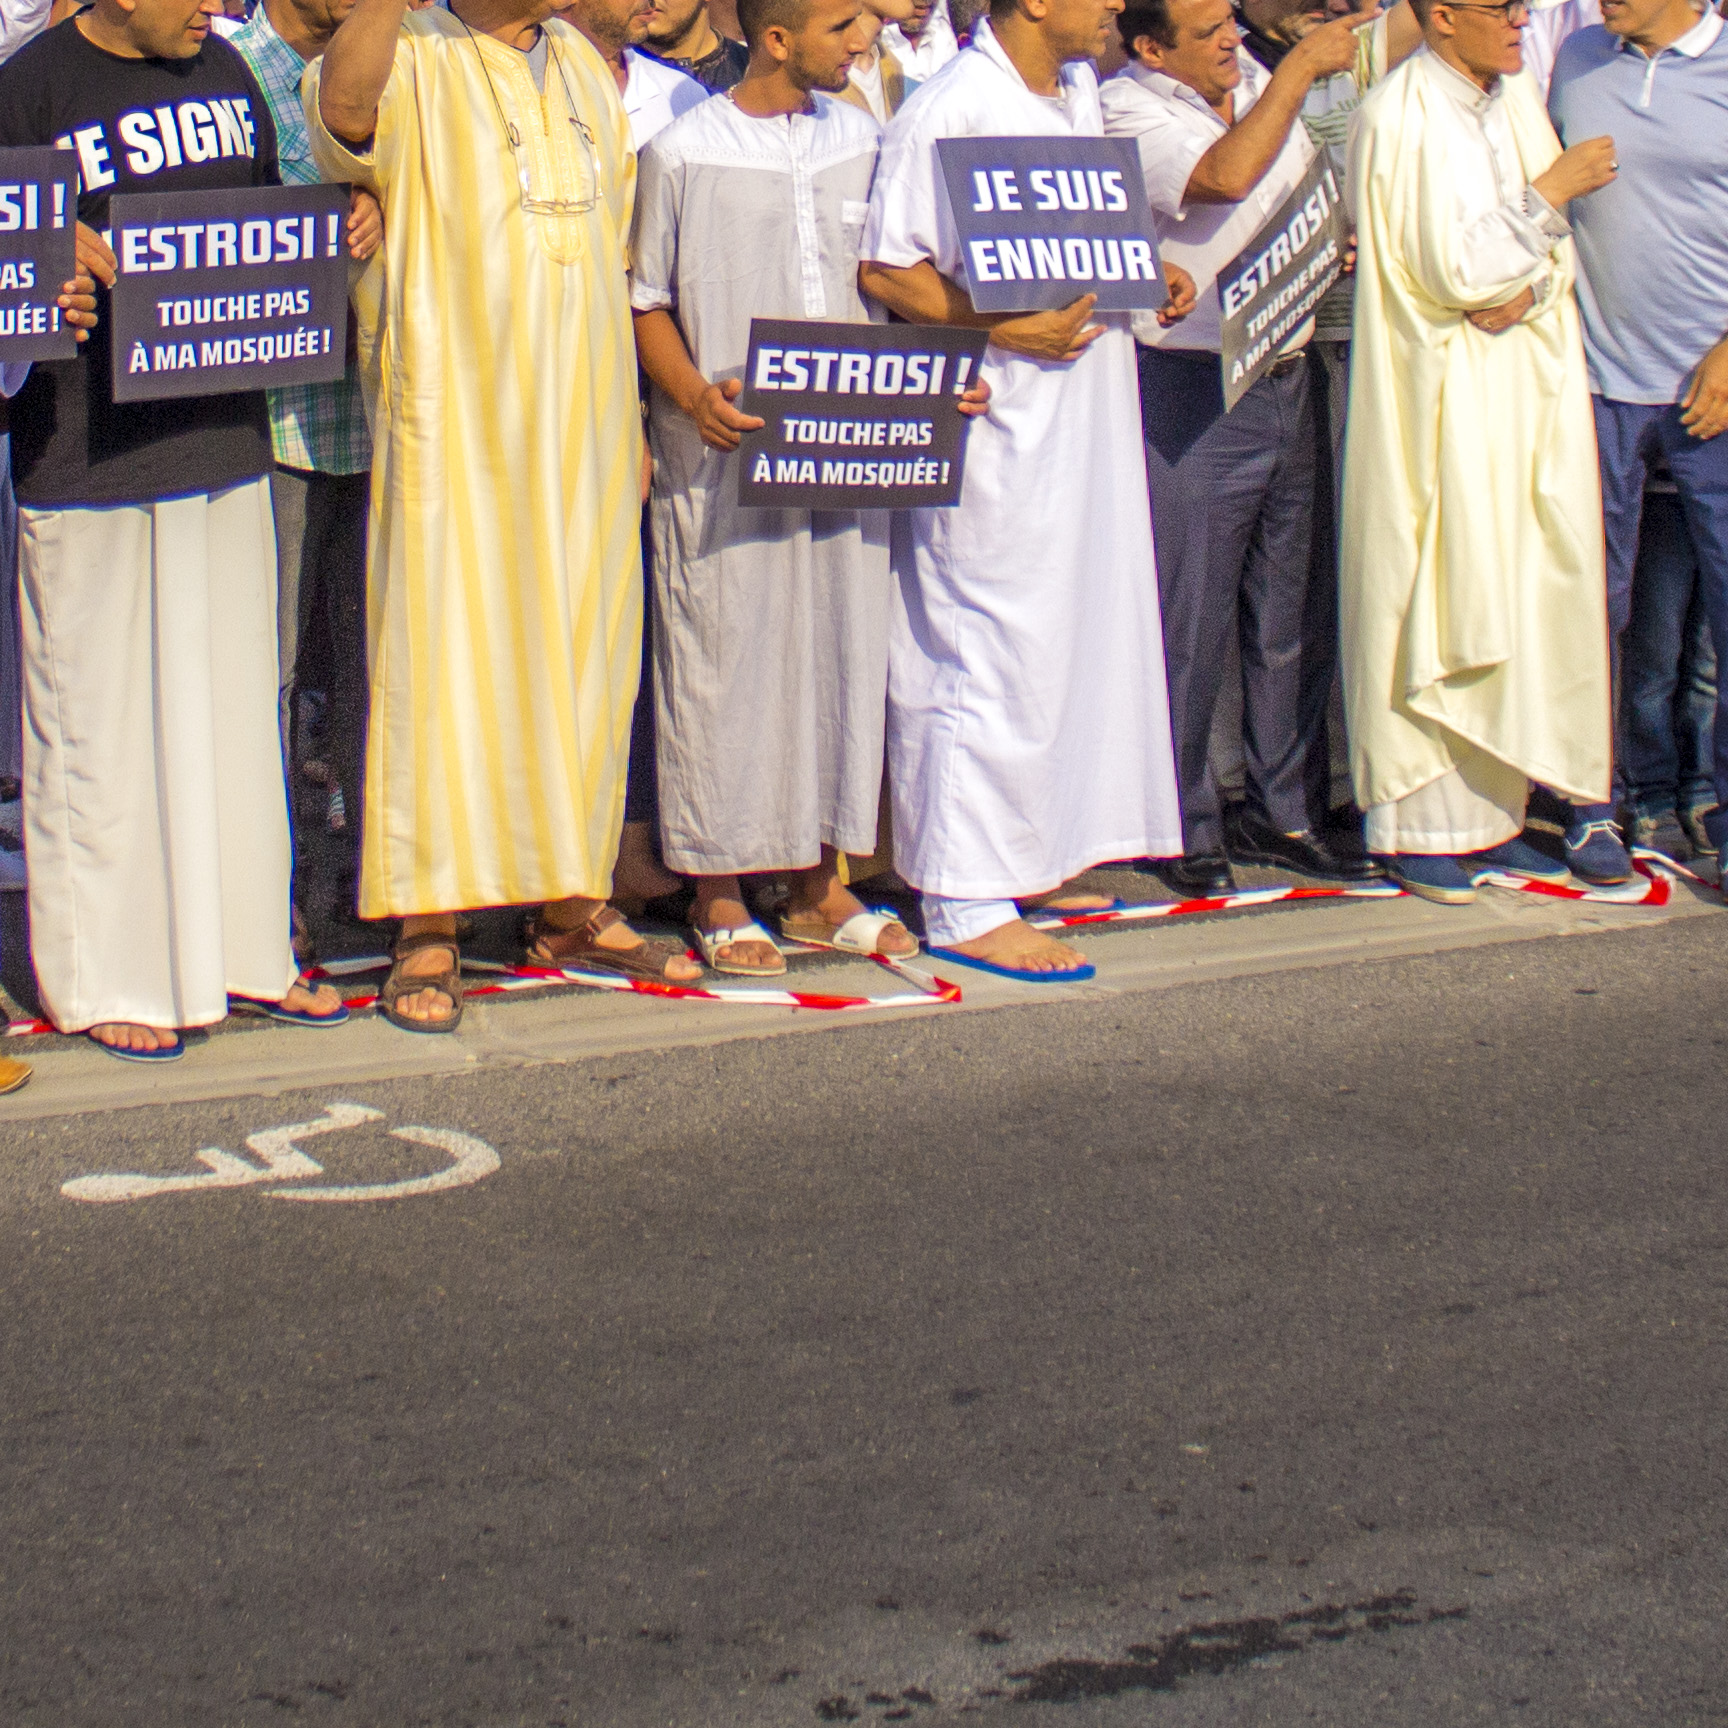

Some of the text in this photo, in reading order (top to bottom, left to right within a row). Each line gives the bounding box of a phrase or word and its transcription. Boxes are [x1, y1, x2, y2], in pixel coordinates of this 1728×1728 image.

[119, 99, 254, 174] SIGNE
[973, 169, 1128, 212] JE SUIS
[121, 216, 315, 274] ESTROSI
[969, 238, 1157, 282] ENNOUR
[1223, 183, 1330, 321] ESTROSI
[157, 289, 310, 327] TOUCHE PAS
[1246, 267, 1309, 339] TOUCHE
[129, 326, 318, 374] À MA MOSQUÉE
[754, 348, 947, 395] ESTROSI
[1231, 336, 1271, 384] À MA
[783, 418, 933, 446] TOUCHE PAS
[753, 453, 939, 488] À MA MOSQUÉE
